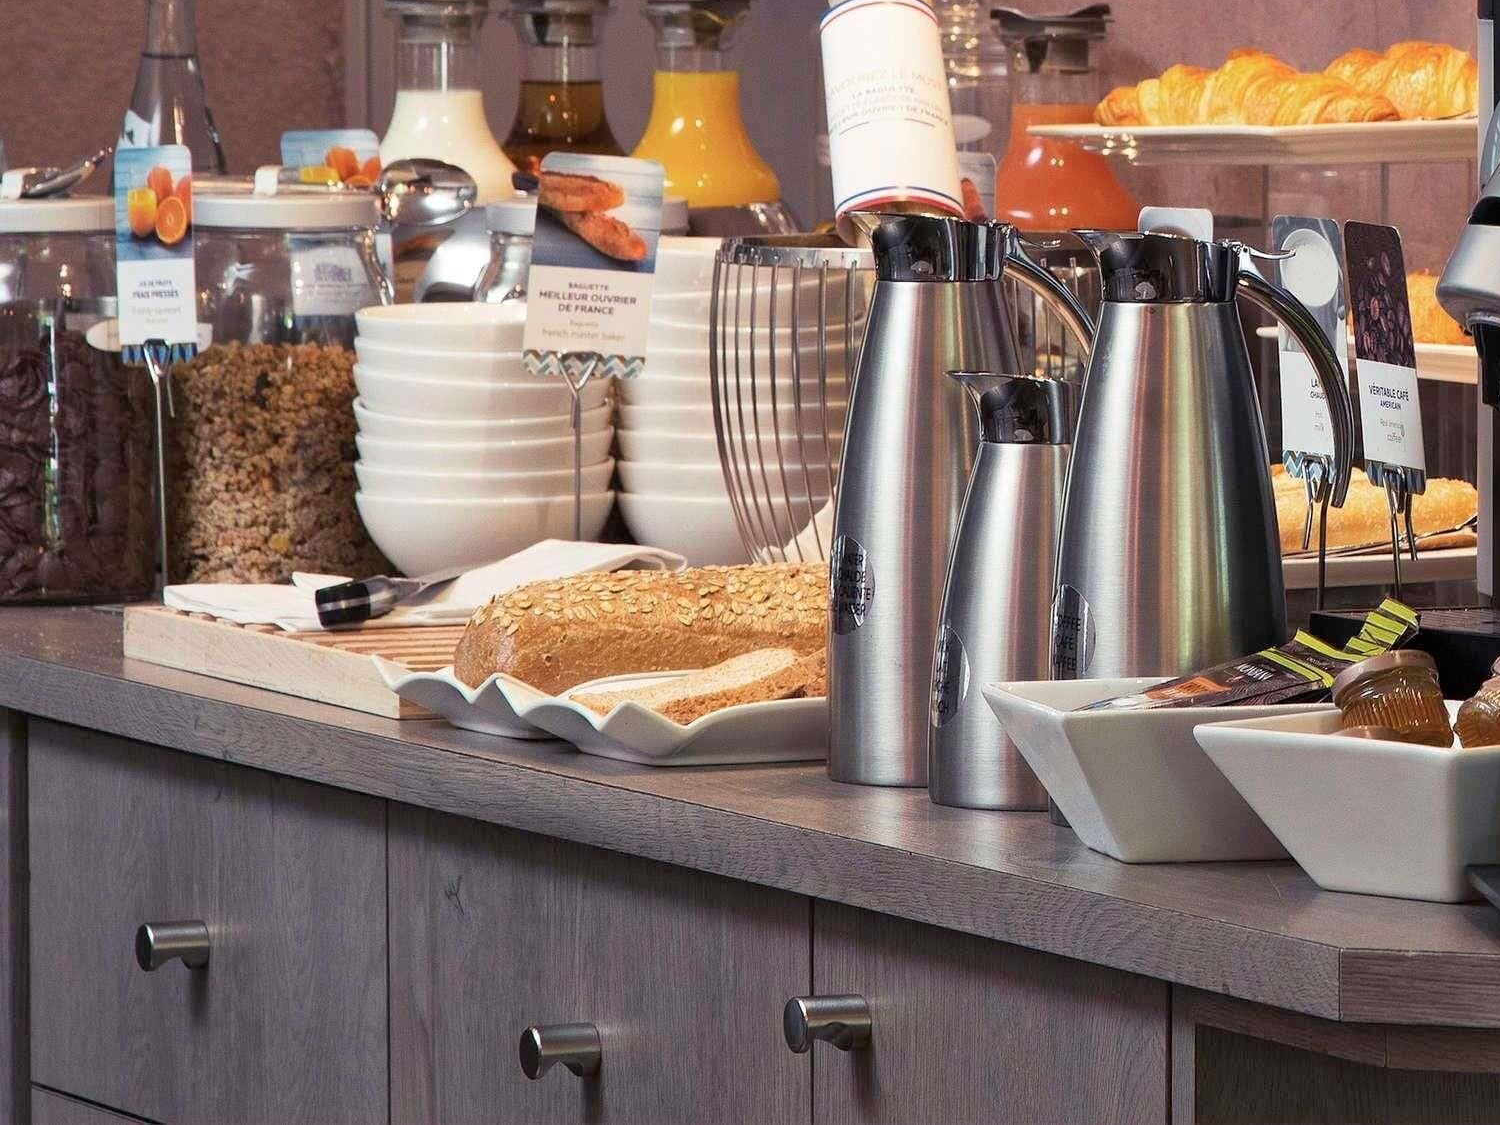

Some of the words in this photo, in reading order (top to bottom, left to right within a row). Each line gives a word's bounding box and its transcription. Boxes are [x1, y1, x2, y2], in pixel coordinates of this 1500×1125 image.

[569, 282, 608, 291] BAGUETTE
[540, 291, 589, 301] MEILLEUR
[591, 293, 637, 305] OUVRIER
[558, 303, 573, 312] DE
[575, 304, 615, 315] FRANCE
